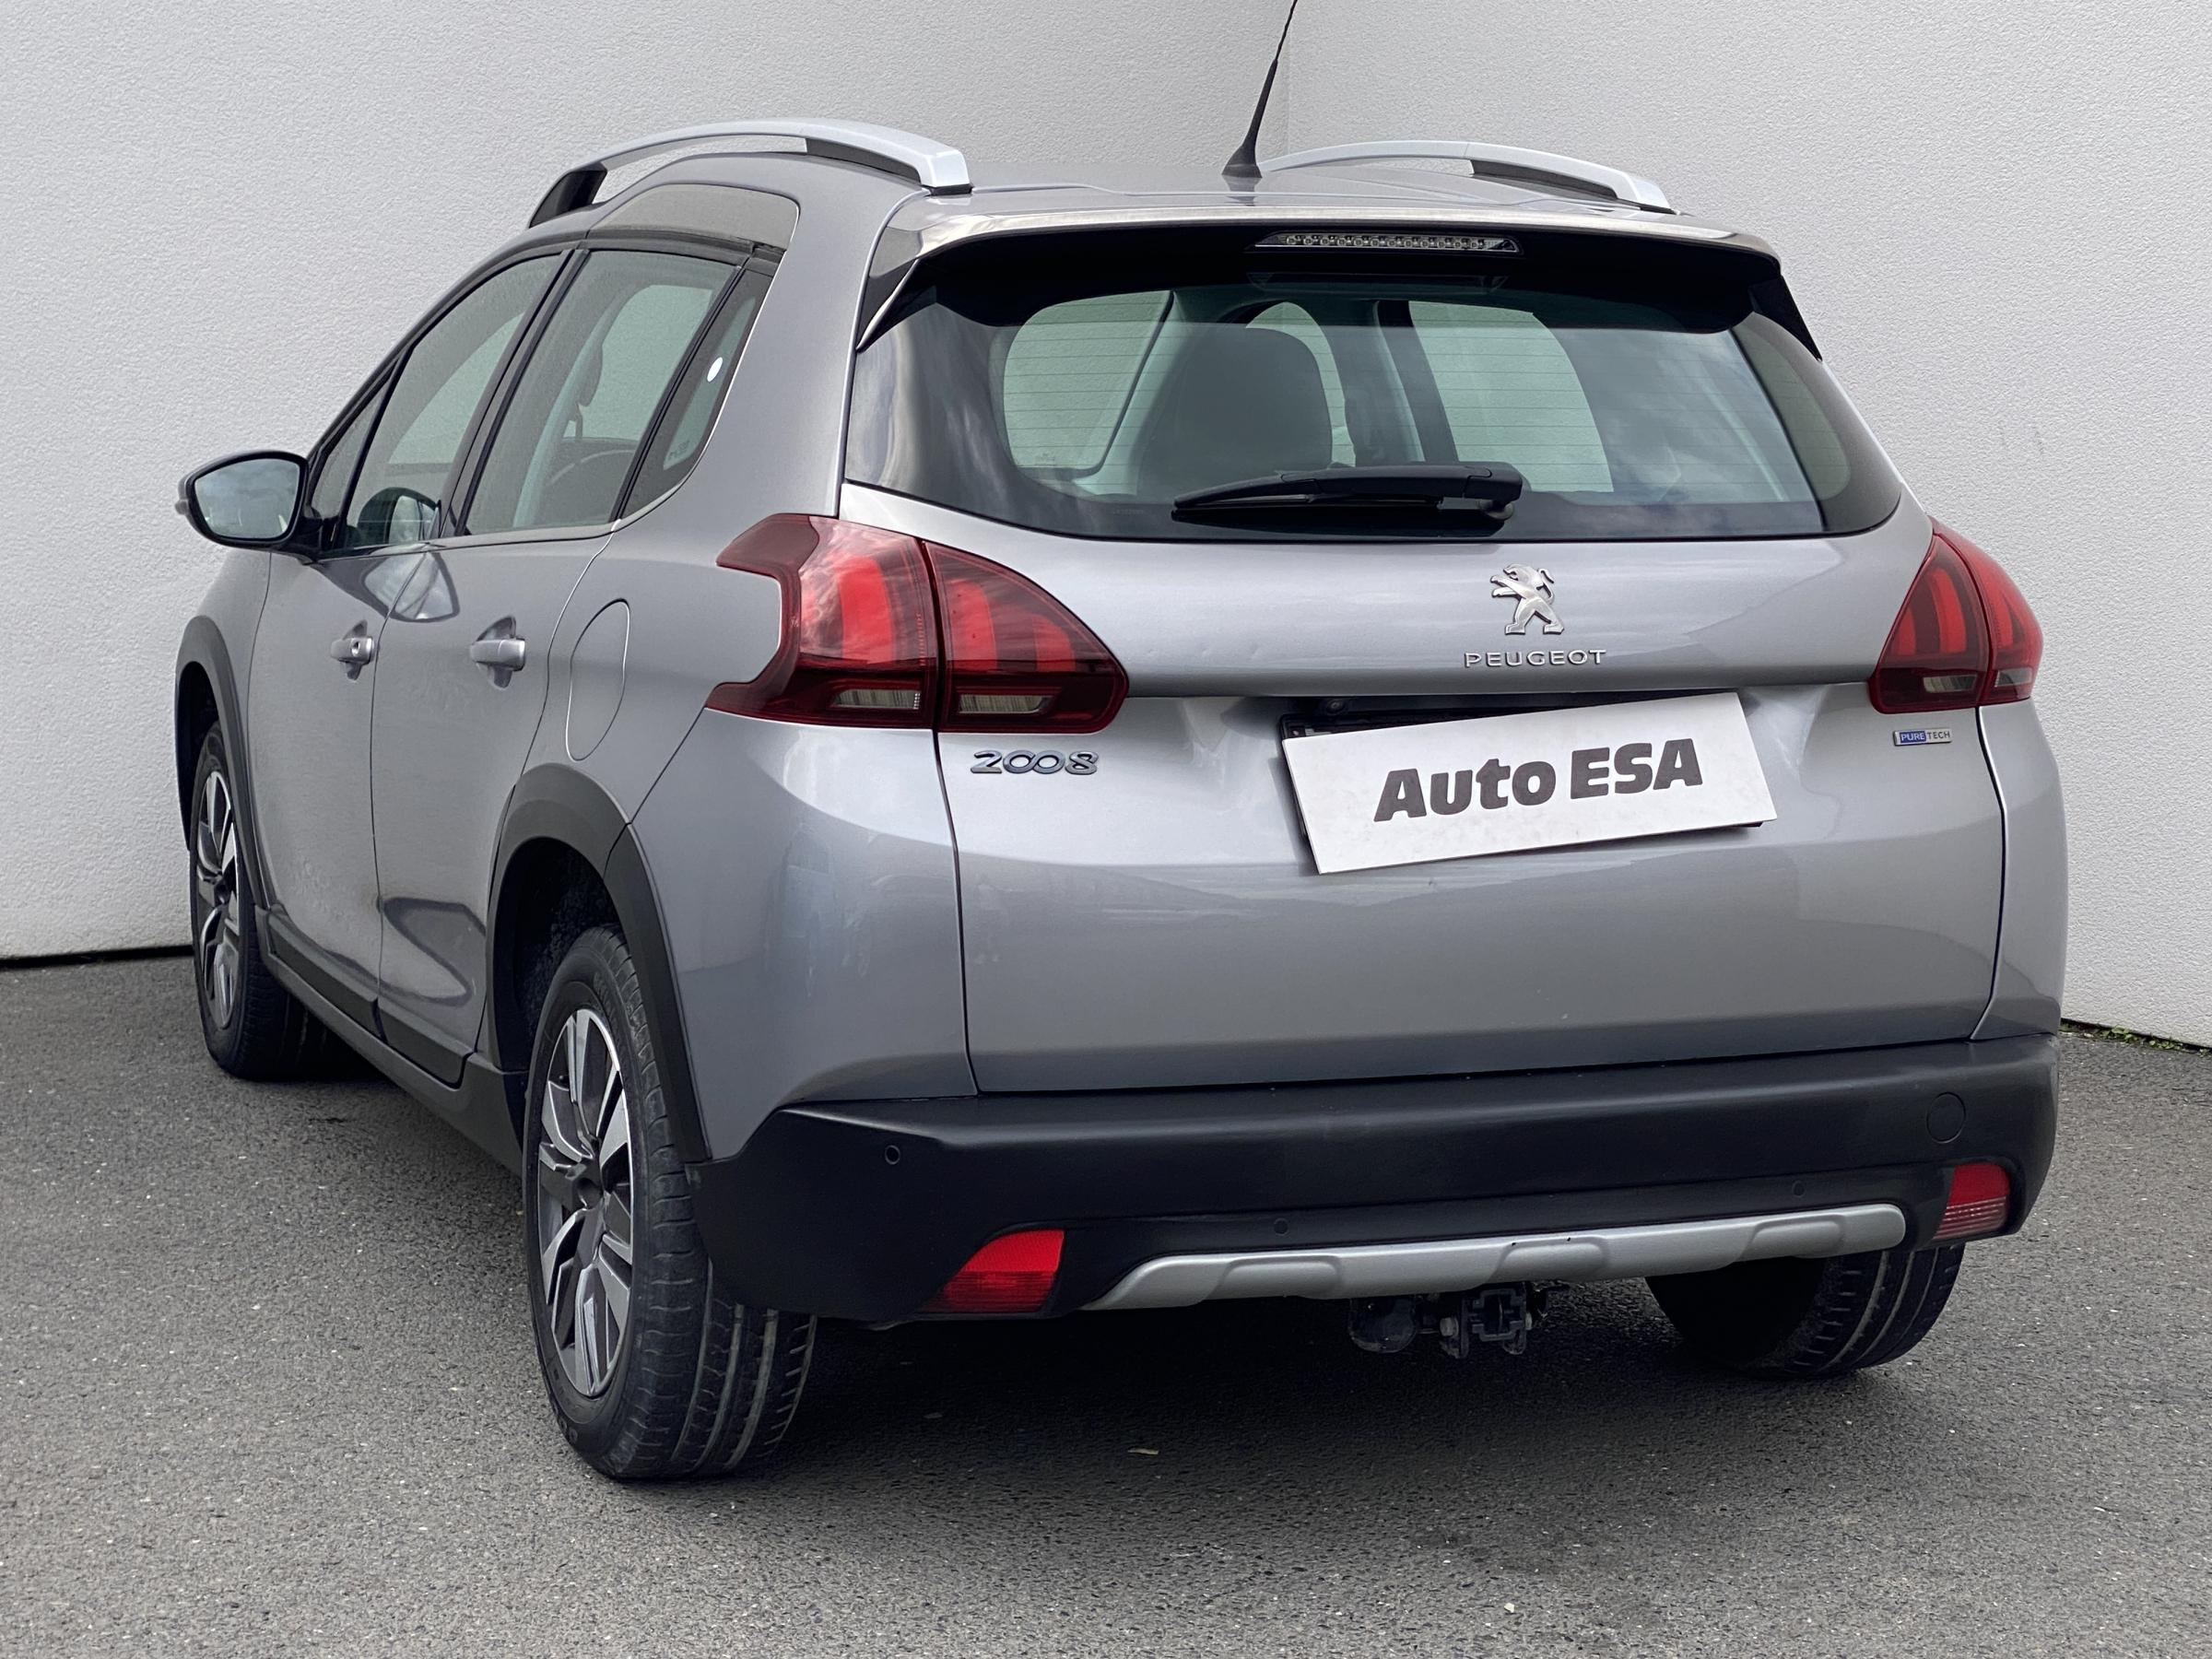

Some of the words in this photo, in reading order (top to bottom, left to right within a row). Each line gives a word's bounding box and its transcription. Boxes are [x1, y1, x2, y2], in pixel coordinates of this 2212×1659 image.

[1465, 649, 1607, 669] PEUGEOT
[971, 748, 1099, 776] 2008
[1373, 758, 1556, 823] Auto
[1570, 736, 1703, 801] ESA
